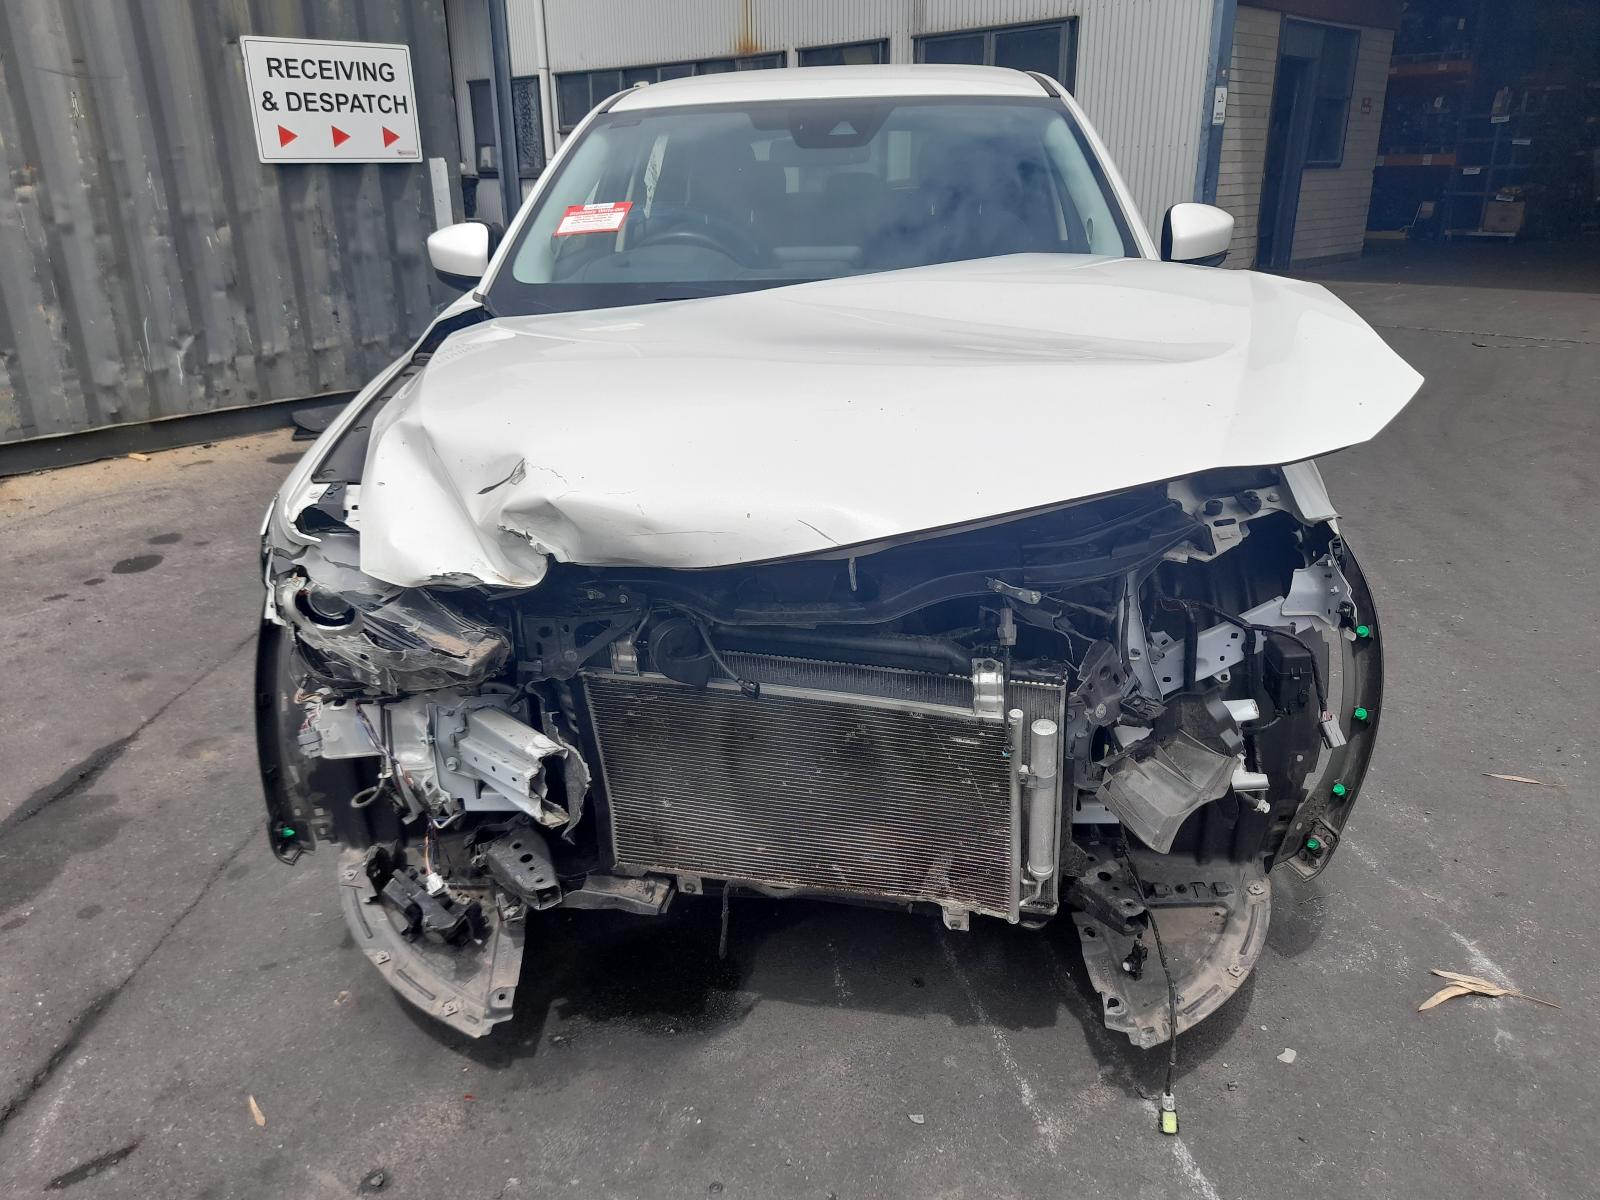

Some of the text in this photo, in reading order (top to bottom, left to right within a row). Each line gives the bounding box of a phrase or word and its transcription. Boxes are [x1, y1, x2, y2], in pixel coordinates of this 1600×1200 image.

[266, 57, 395, 82] RECEIVING
[262, 90, 408, 114] & DESPATCH
